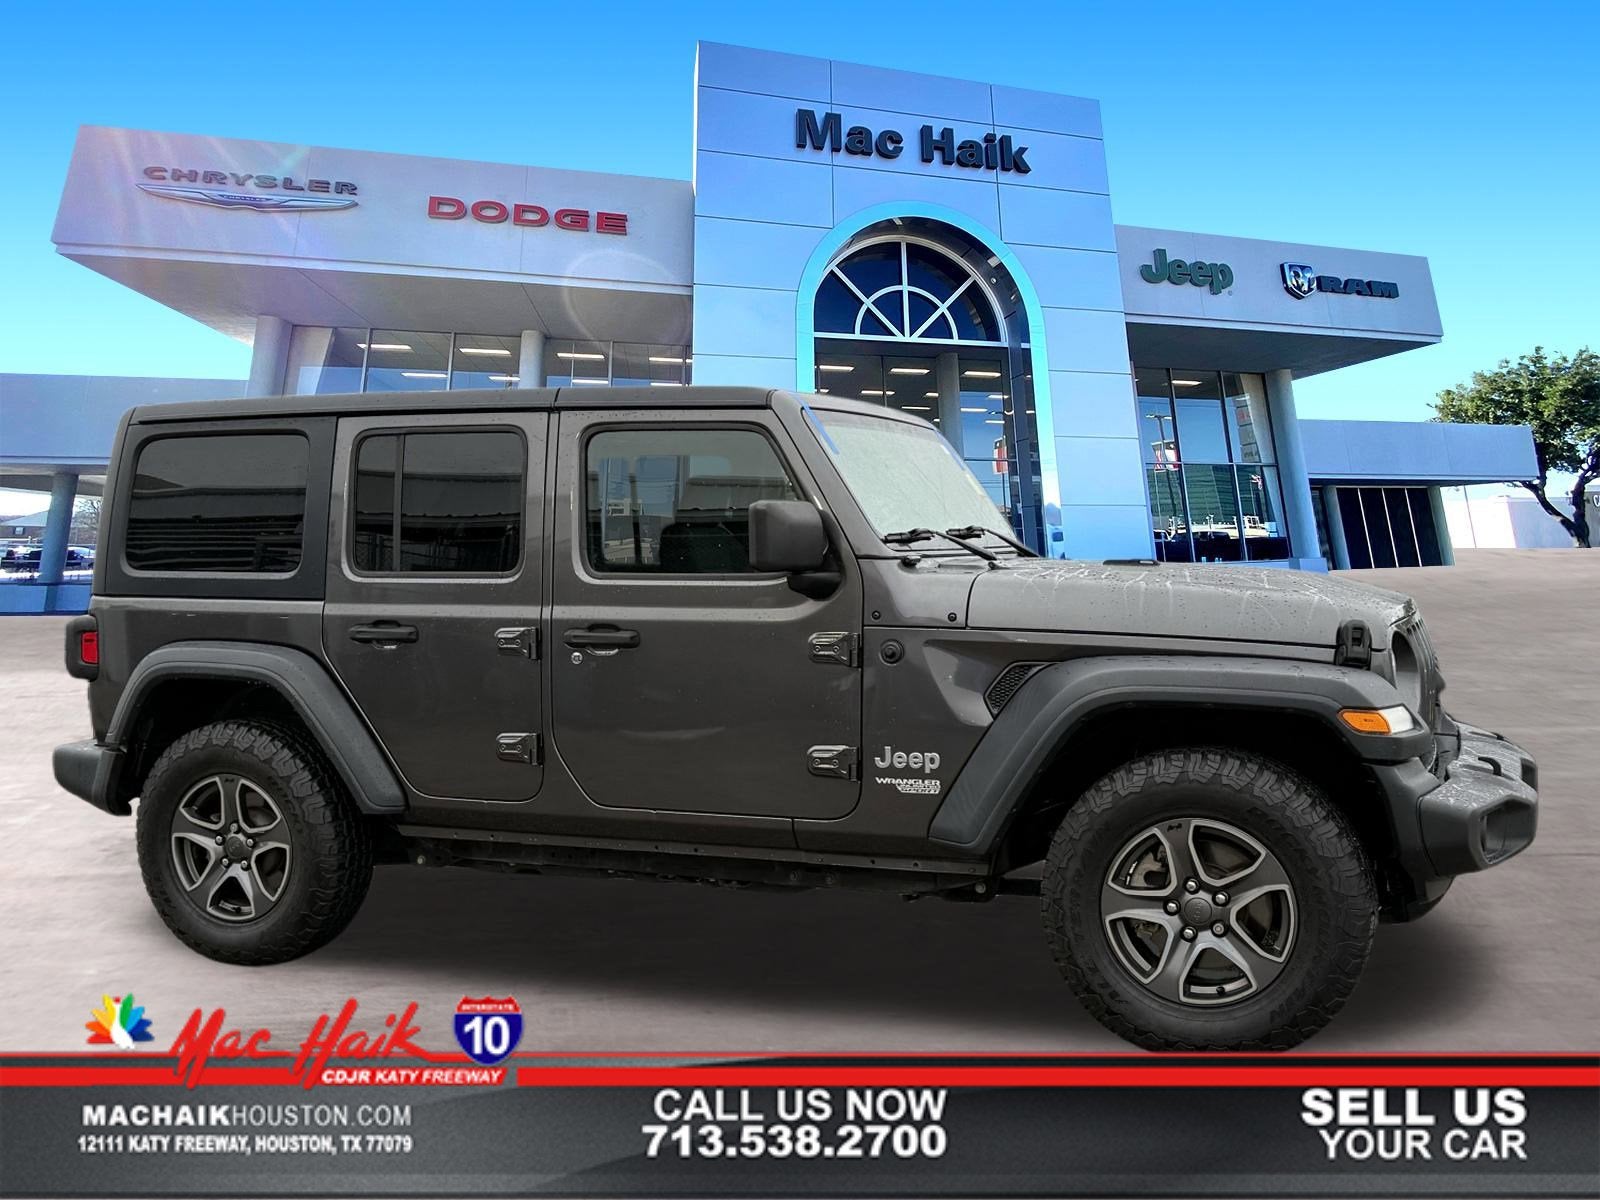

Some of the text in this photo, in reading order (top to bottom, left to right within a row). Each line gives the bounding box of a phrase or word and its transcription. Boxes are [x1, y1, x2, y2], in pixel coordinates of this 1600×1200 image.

[796, 108, 1032, 174] Mac Haik
[143, 166, 358, 196] CHRYSLER
[428, 196, 628, 236] DODGE
[1139, 248, 1234, 295] Jeep
[1316, 275, 1399, 299] RAM
[874, 746, 940, 774] Jeep
[875, 777, 940, 786] WRANGLER
